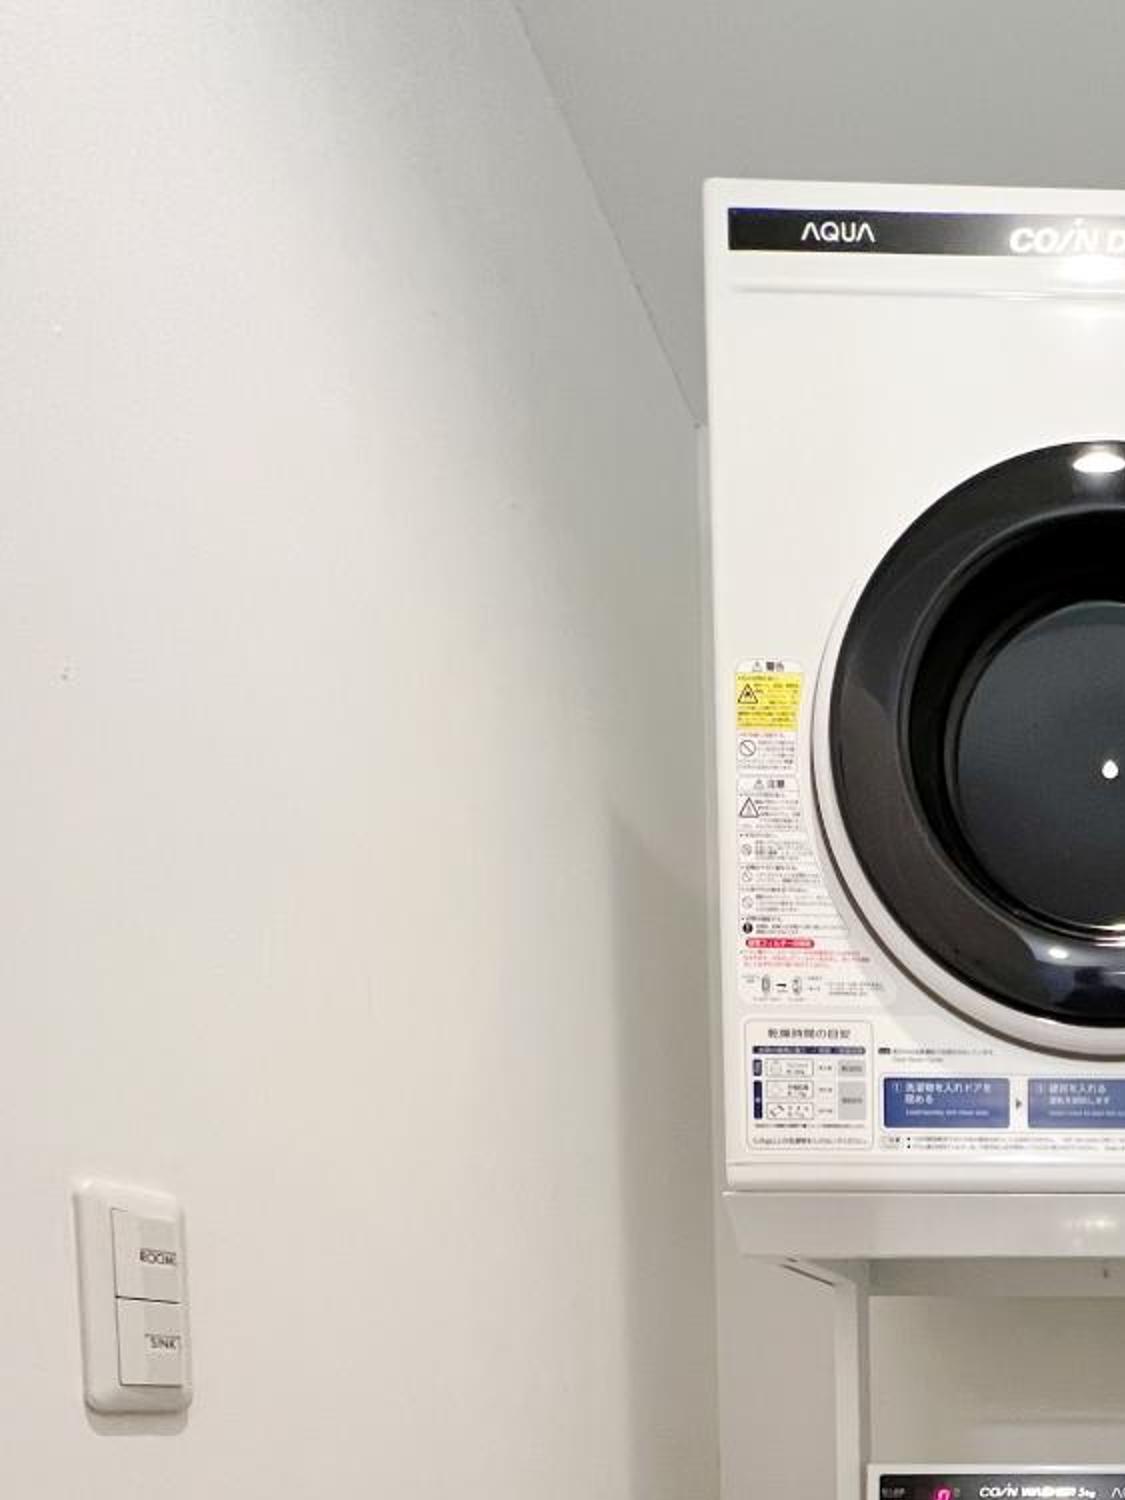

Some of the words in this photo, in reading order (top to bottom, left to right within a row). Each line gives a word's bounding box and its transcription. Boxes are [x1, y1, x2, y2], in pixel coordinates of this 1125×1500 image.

[801, 221, 876, 243] AQUA
[1009, 217, 1104, 253] COIN
[140, 1250, 177, 1265] ROOM
